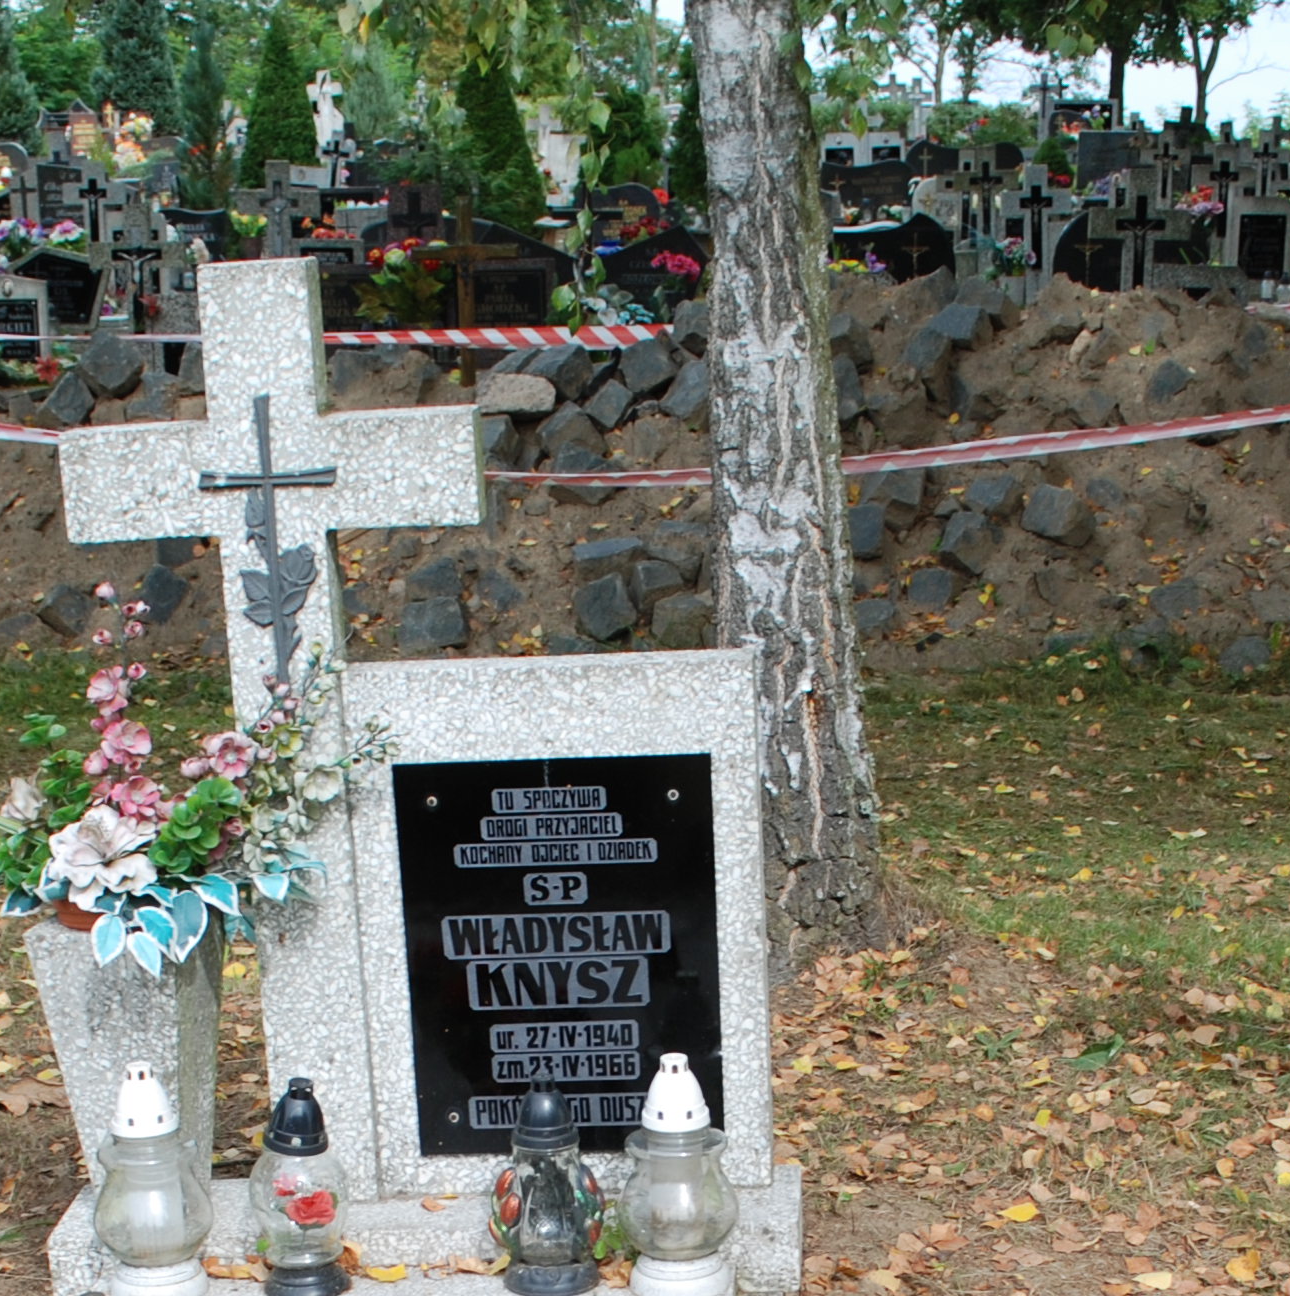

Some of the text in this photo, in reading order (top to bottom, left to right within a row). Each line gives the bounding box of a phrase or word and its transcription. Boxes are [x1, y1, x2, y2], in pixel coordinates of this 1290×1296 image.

[496, 787, 601, 810] TU SPOCZYWA
[486, 814, 619, 838] DROGI PRZYJACIEL
[460, 845, 523, 865] KOCHANY
[532, 843, 580, 862] OJCIEC
[598, 840, 652, 861] DZIADEK
[448, 913, 663, 956] WŁADYSŁAW
[475, 958, 643, 1007] KNYSZ
[496, 1030, 519, 1050] ur.
[475, 1095, 522, 1126] POKÓ
[599, 1094, 646, 1123] DUSZ
